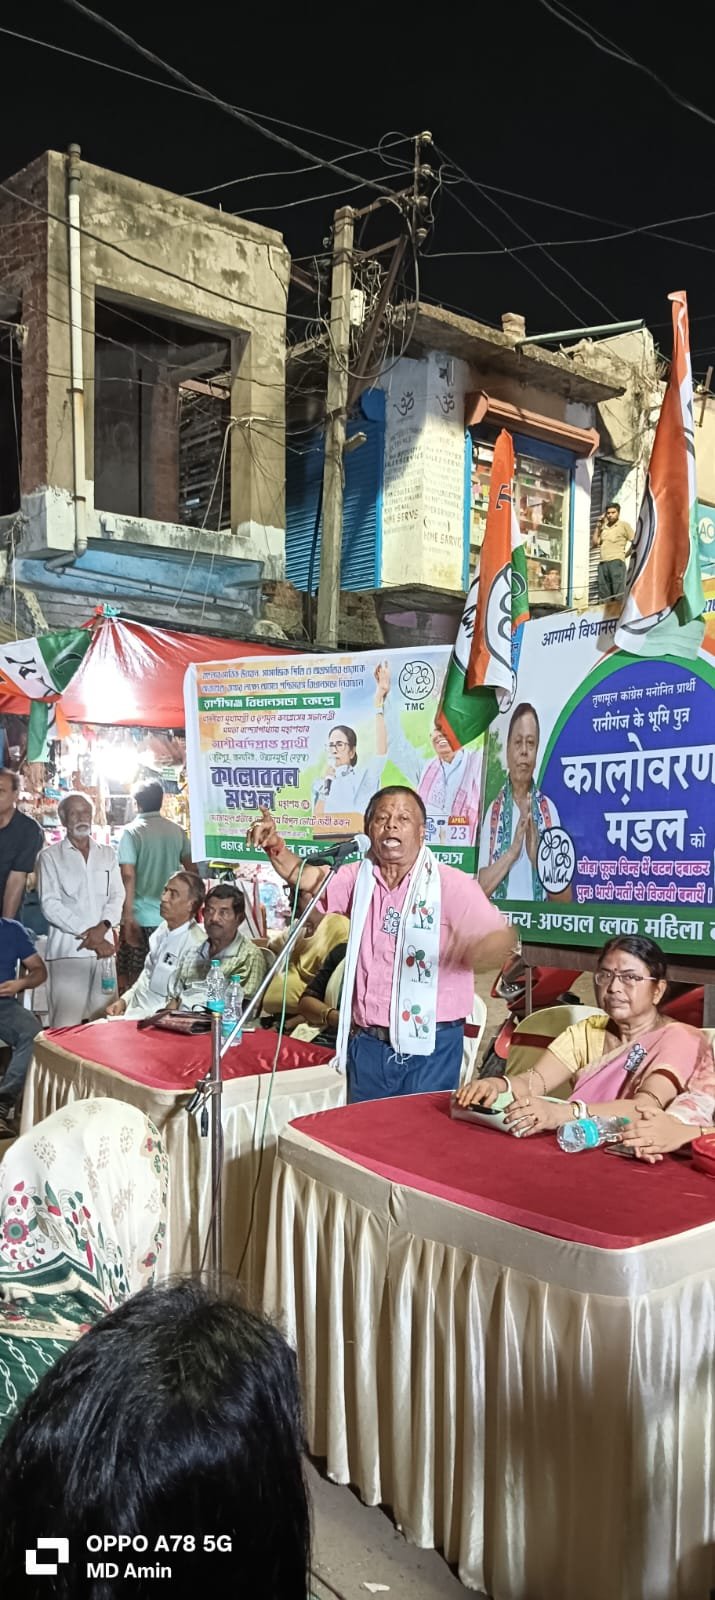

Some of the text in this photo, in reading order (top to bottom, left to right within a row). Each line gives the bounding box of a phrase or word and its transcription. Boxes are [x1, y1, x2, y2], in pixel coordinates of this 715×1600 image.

[541, 622, 576, 647] आगामी
[578, 618, 620, 640] विधानस
[307, 678, 337, 688] বিধানসভা
[592, 677, 697, 708] तृणमूल कांग्रेस मनोनित प्रार्थी
[203, 696, 336, 710] রাণীগঞ্জ বিধানসভা কেন্দ্রে
[404, 702, 425, 711] TMC
[592, 704, 692, 732] रानीगंज के भूमि पुत्र
[280, 736, 309, 750] প্রার্থী
[560, 732, 715, 795] कालोवरण
[223, 789, 277, 811] মণ্ডল
[451, 816, 467, 825] APRIL
[604, 793, 707, 853] मंडल को
[450, 826, 466, 840] 23
[577, 855, 712, 880] जोड़ा फूल चिन्ह में बटन दबाकर
[594, 881, 614, 901] भारी
[634, 881, 646, 901] से
[647, 881, 677, 902] विजयी
[644, 912, 705, 941] महिला
